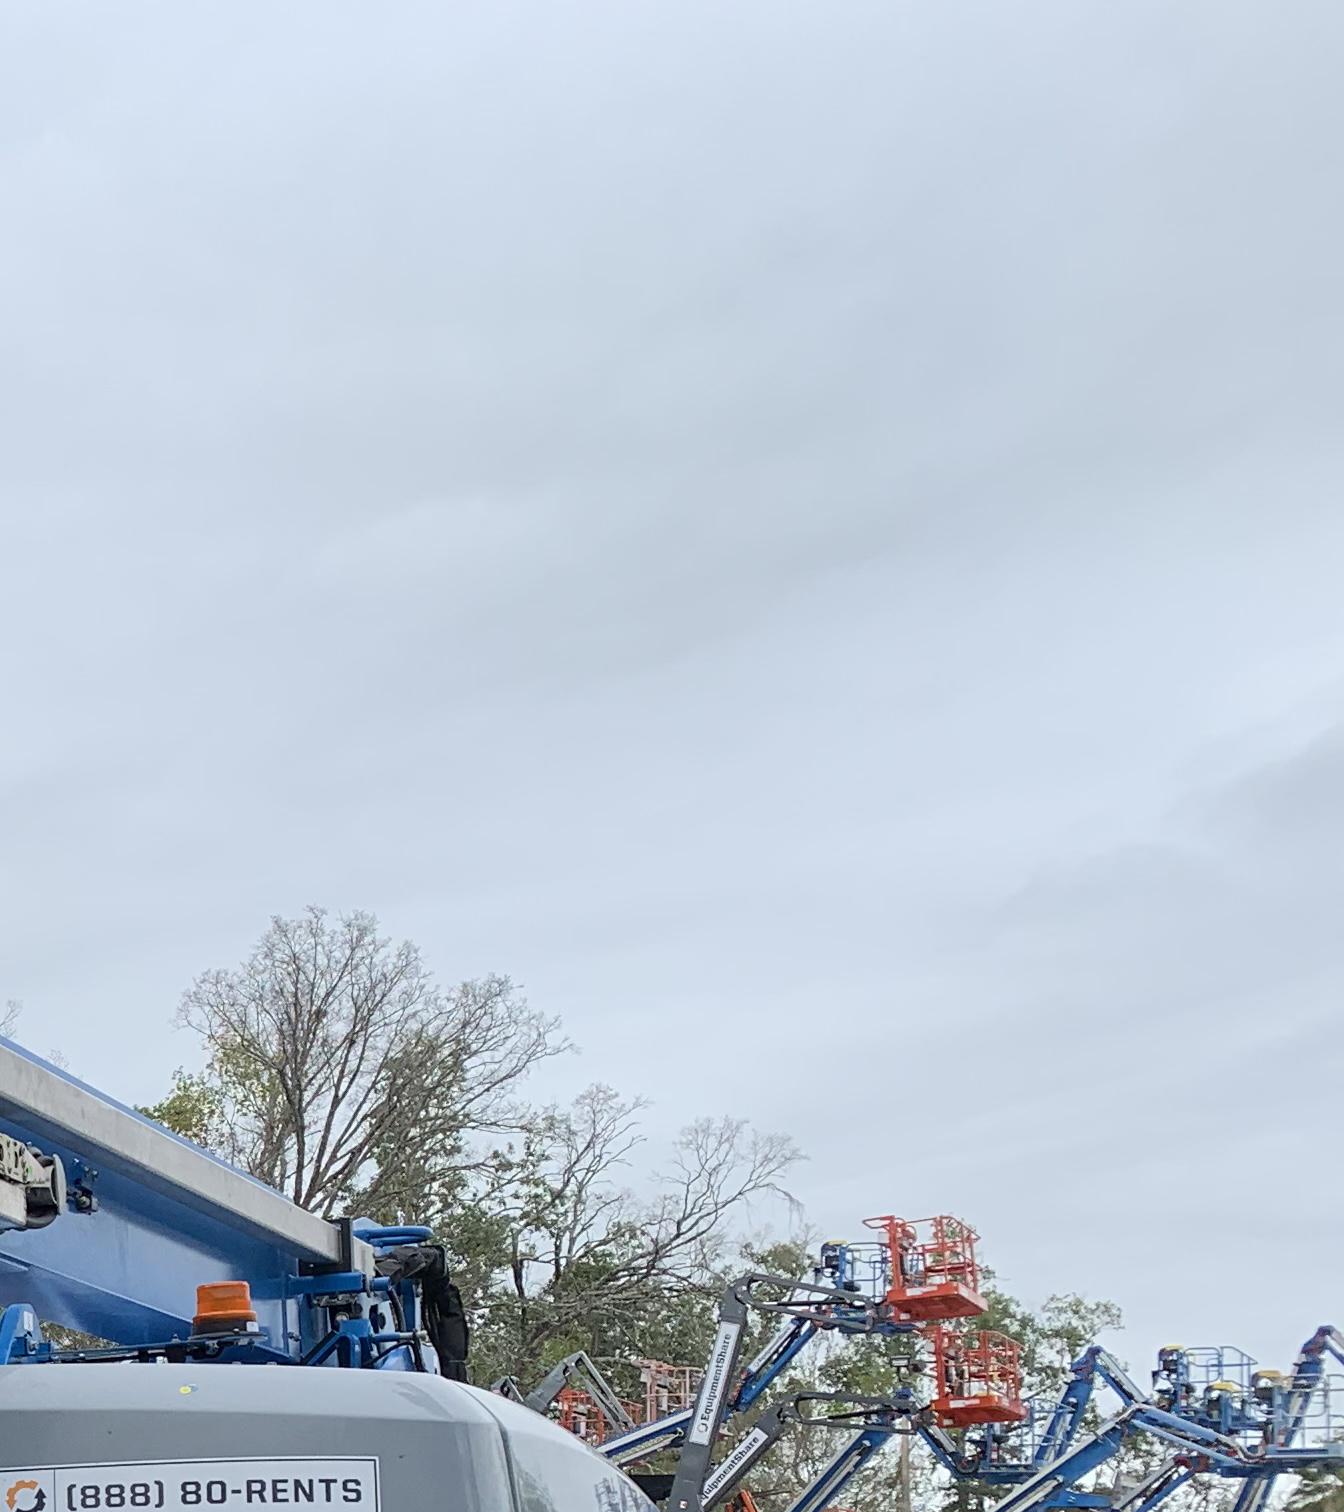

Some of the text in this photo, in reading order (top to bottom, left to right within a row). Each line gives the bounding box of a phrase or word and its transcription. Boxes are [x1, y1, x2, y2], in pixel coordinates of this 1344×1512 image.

[700, 1333, 732, 1422] EquipmentShare
[67, 1478, 362, 1511] (888) 80-RENTS
[701, 1436, 759, 1501] quipmentShare
